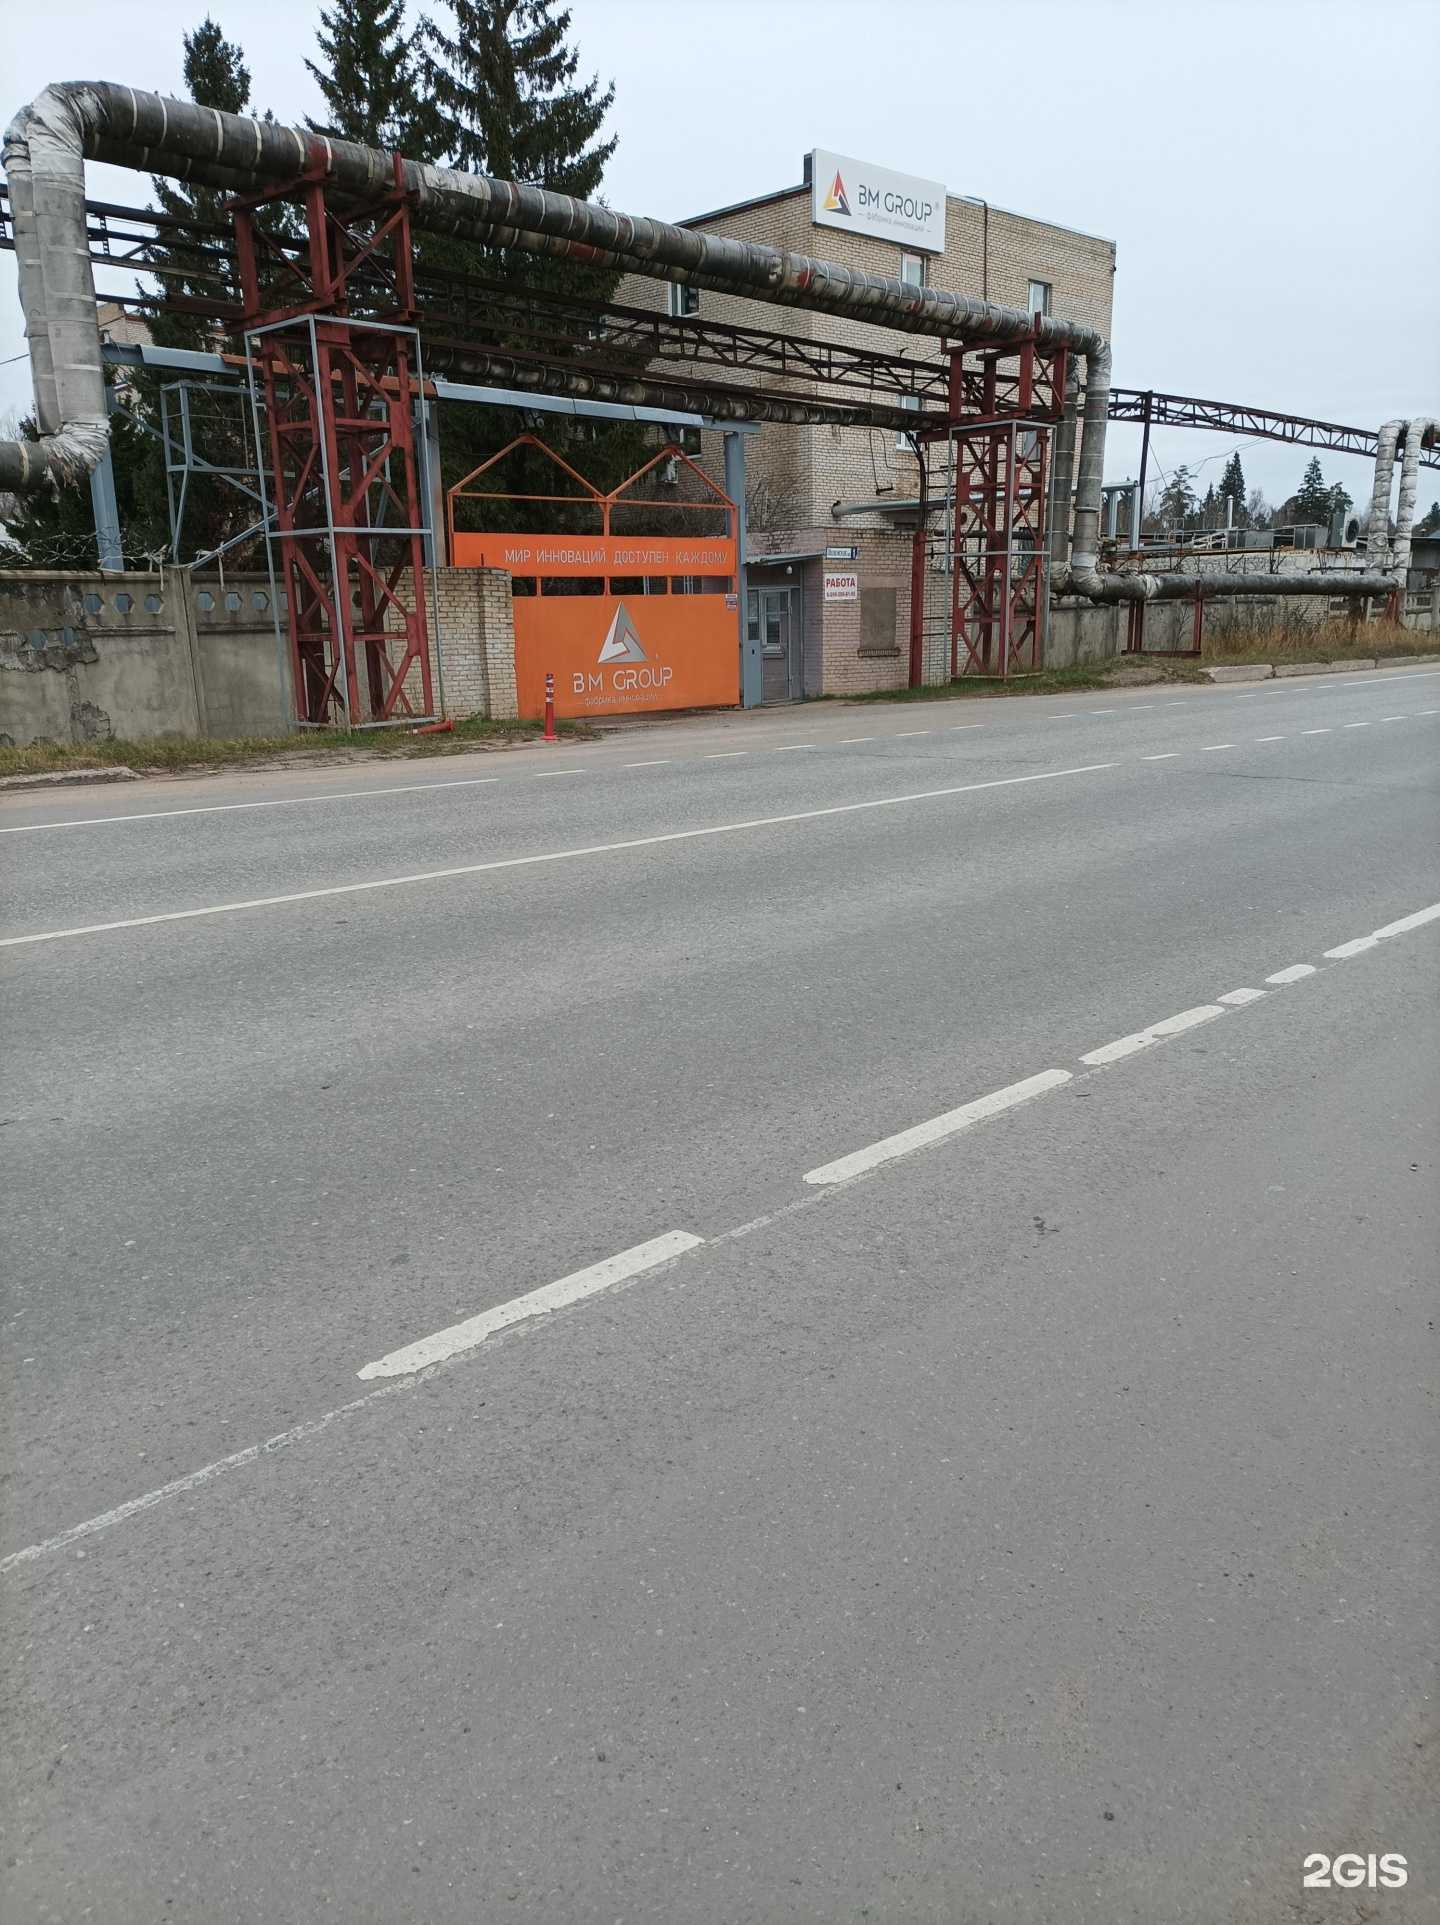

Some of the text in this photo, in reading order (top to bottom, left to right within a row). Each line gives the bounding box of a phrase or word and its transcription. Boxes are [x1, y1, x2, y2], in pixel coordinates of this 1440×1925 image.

[859, 184, 932, 222] BM GROUP
[505, 547, 729, 566] МИР ИННОВАЦИЙ ДОСТУПЕН КАЖДОМУ
[826, 577, 856, 588] РАБОТА
[573, 666, 673, 693] BM GROUP
